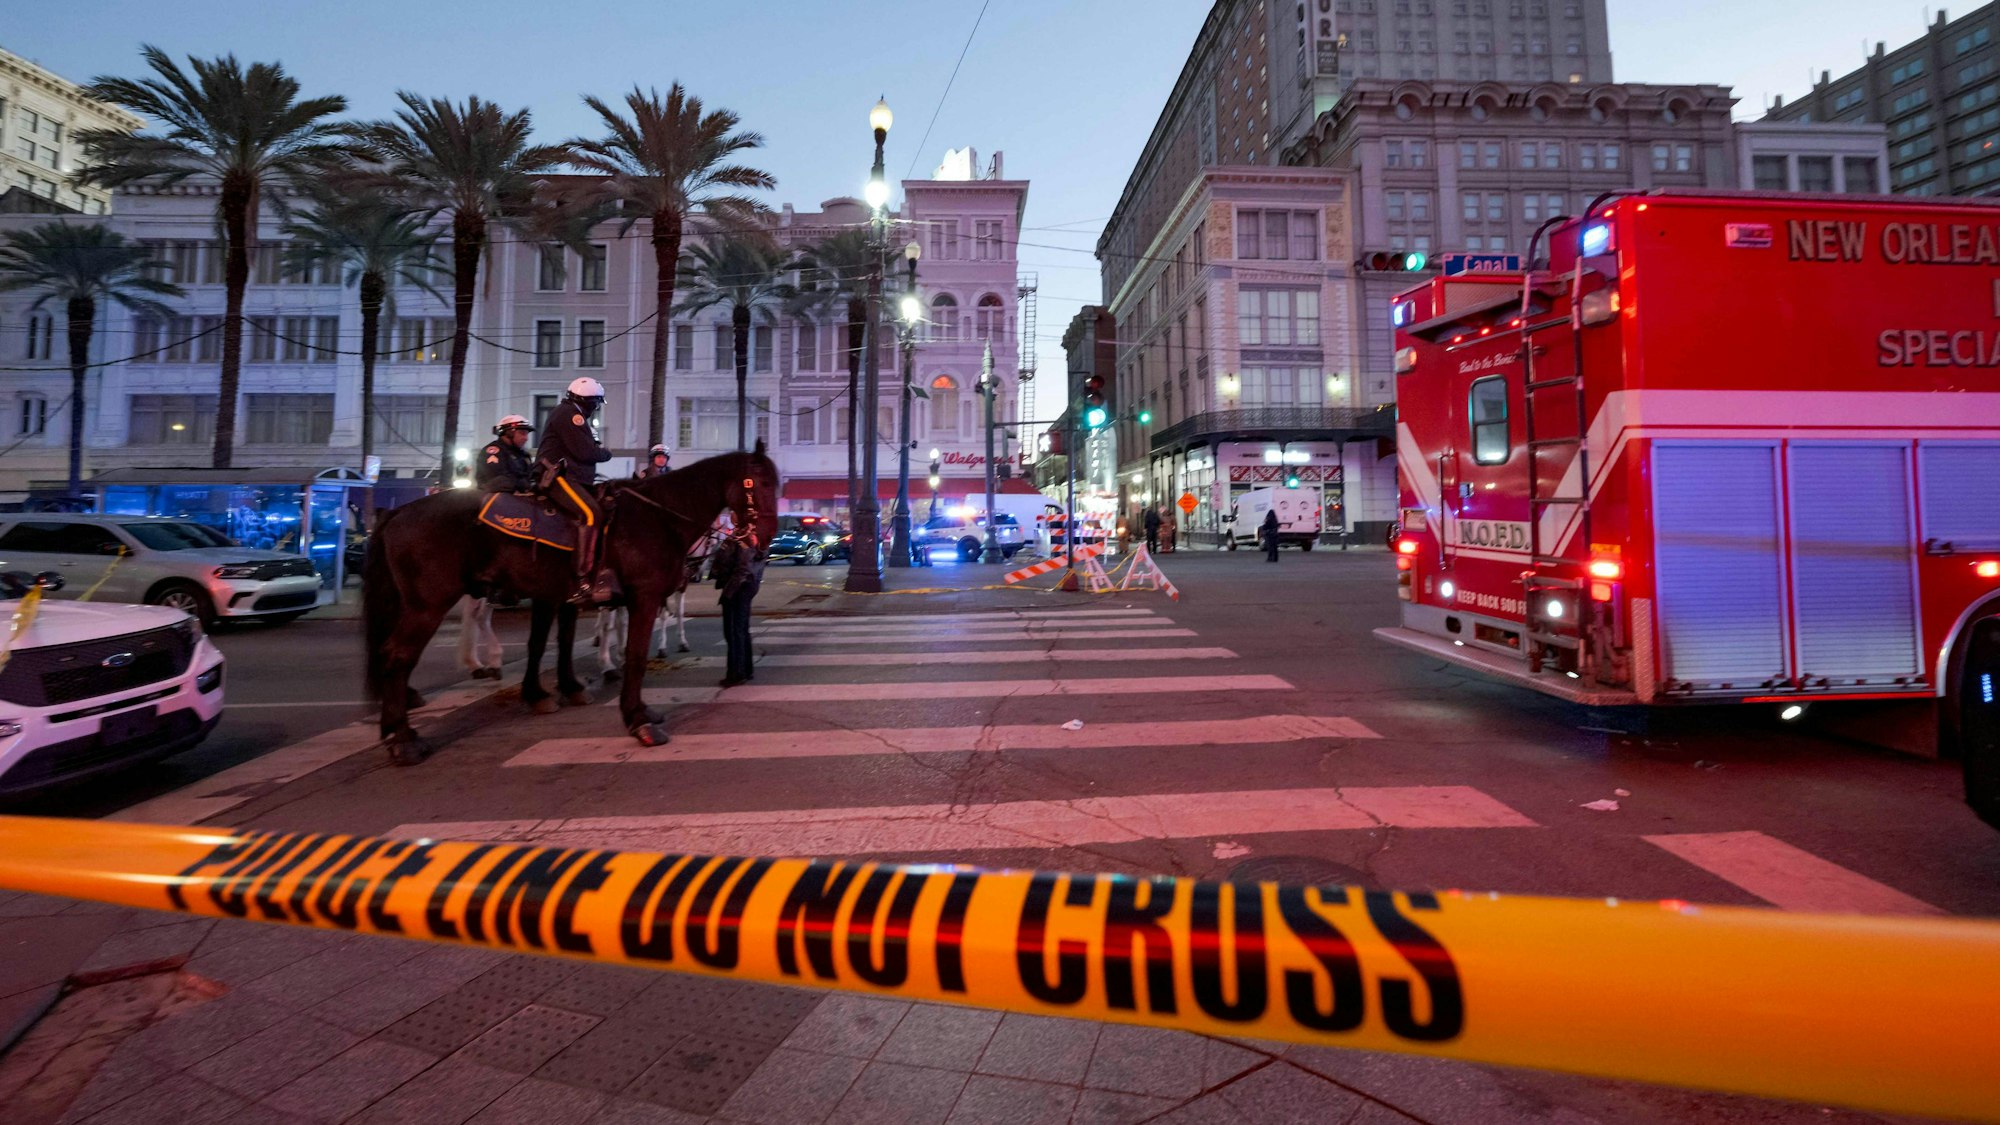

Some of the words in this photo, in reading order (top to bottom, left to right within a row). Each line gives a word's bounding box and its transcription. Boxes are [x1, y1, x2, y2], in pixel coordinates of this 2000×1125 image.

[1788, 219, 1867, 262] NEW
[1881, 222, 2000, 265] ORLEA
[1463, 255, 1507, 271] Canal
[1481, 355, 1493, 370] the
[1460, 521, 1531, 550] N.O.F.D.
[1457, 589, 1477, 605] KEEP
[1477, 593, 1500, 609] BACK
[1500, 597, 1517, 614] 500
[168, 828, 436, 935] POLICE
[425, 842, 623, 954] LINE
[620, 852, 777, 970] DO
[776, 860, 982, 994] NOT
[1015, 871, 1465, 1042] CROSS
